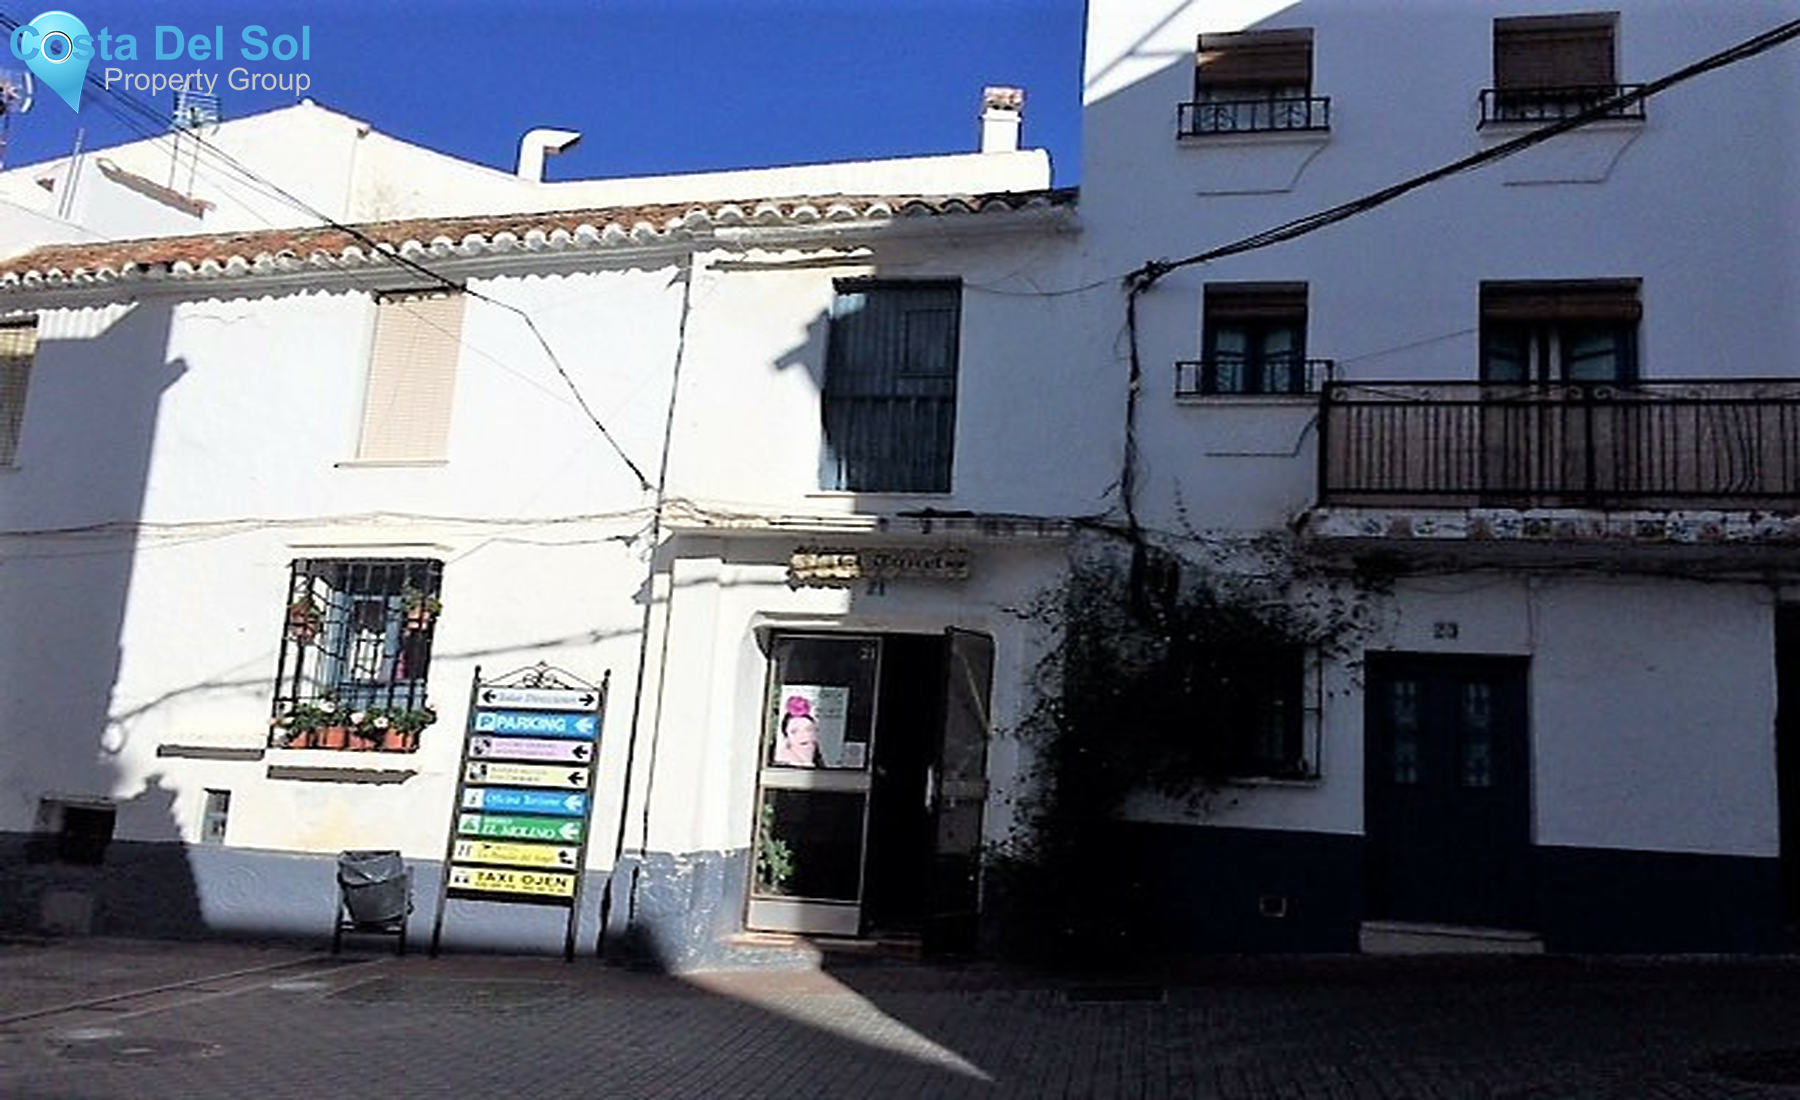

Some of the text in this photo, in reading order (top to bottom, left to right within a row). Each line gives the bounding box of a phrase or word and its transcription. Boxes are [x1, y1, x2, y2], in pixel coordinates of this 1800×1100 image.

[497, 715, 567, 733] PARKING
[477, 871, 514, 883] TAXI
[521, 874, 567, 888] OJEN
